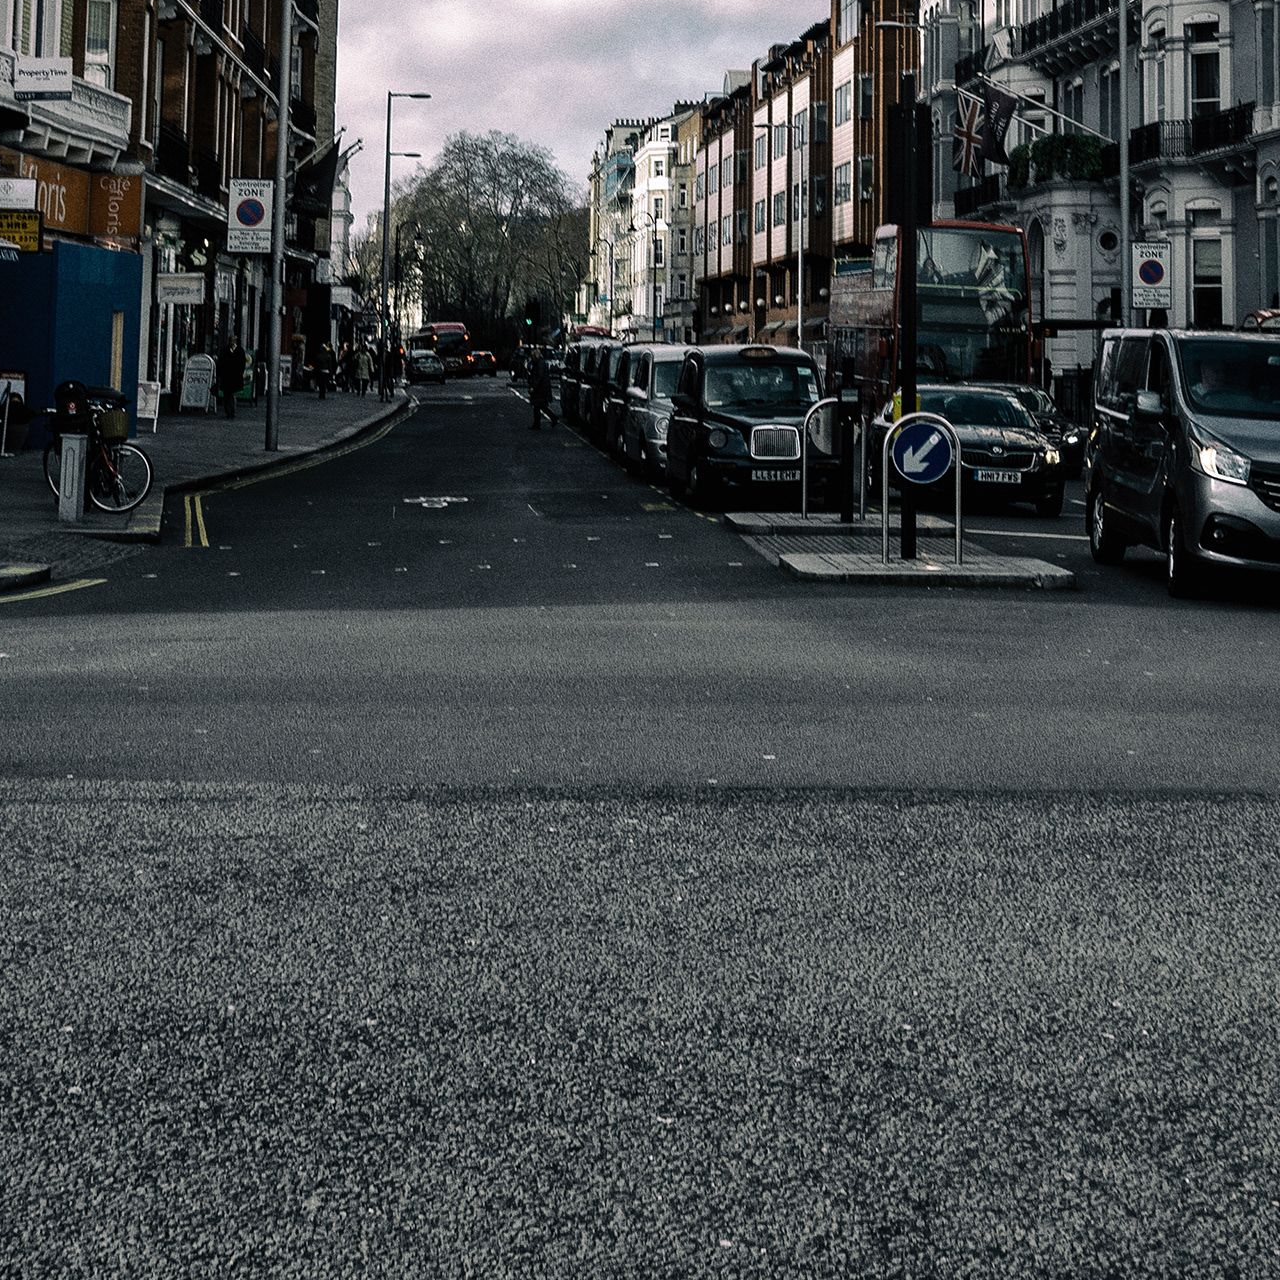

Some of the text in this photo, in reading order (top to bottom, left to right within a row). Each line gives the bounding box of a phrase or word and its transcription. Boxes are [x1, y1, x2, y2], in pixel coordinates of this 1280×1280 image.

[100, 176, 131, 191] Café
[232, 180, 271, 189] Controlled
[238, 188, 265, 197] ZONE
[107, 189, 124, 235] floris
[1140, 250, 1163, 259] ZONE
[186, 377, 208, 385] OPEN
